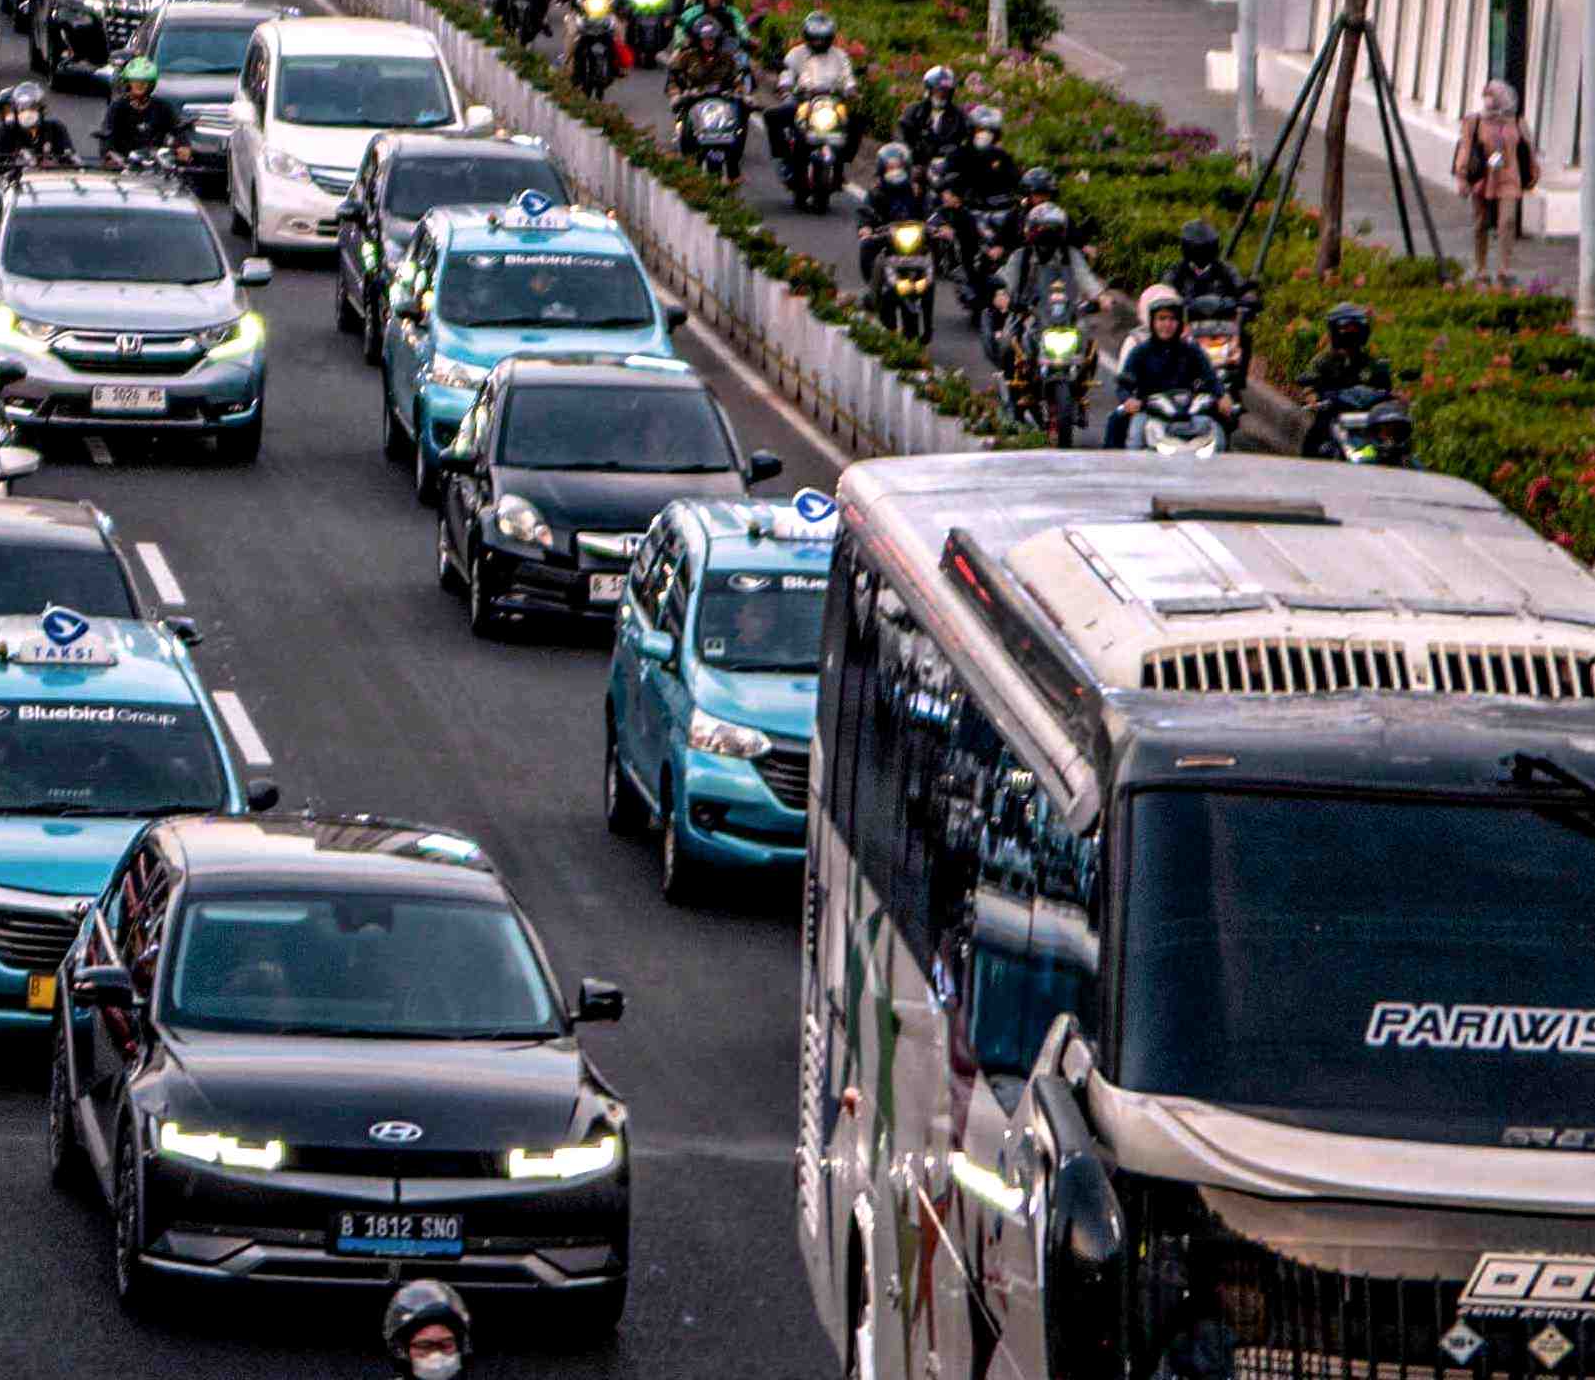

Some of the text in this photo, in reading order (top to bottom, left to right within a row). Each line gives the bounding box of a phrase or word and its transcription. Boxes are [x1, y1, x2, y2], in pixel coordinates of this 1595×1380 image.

[503, 254, 572, 266] Bluebird
[34, 646, 93, 660] TAKSI
[18, 704, 177, 728] Bluebird Group
[341, 1215, 458, 1239] B 1812 SNO
